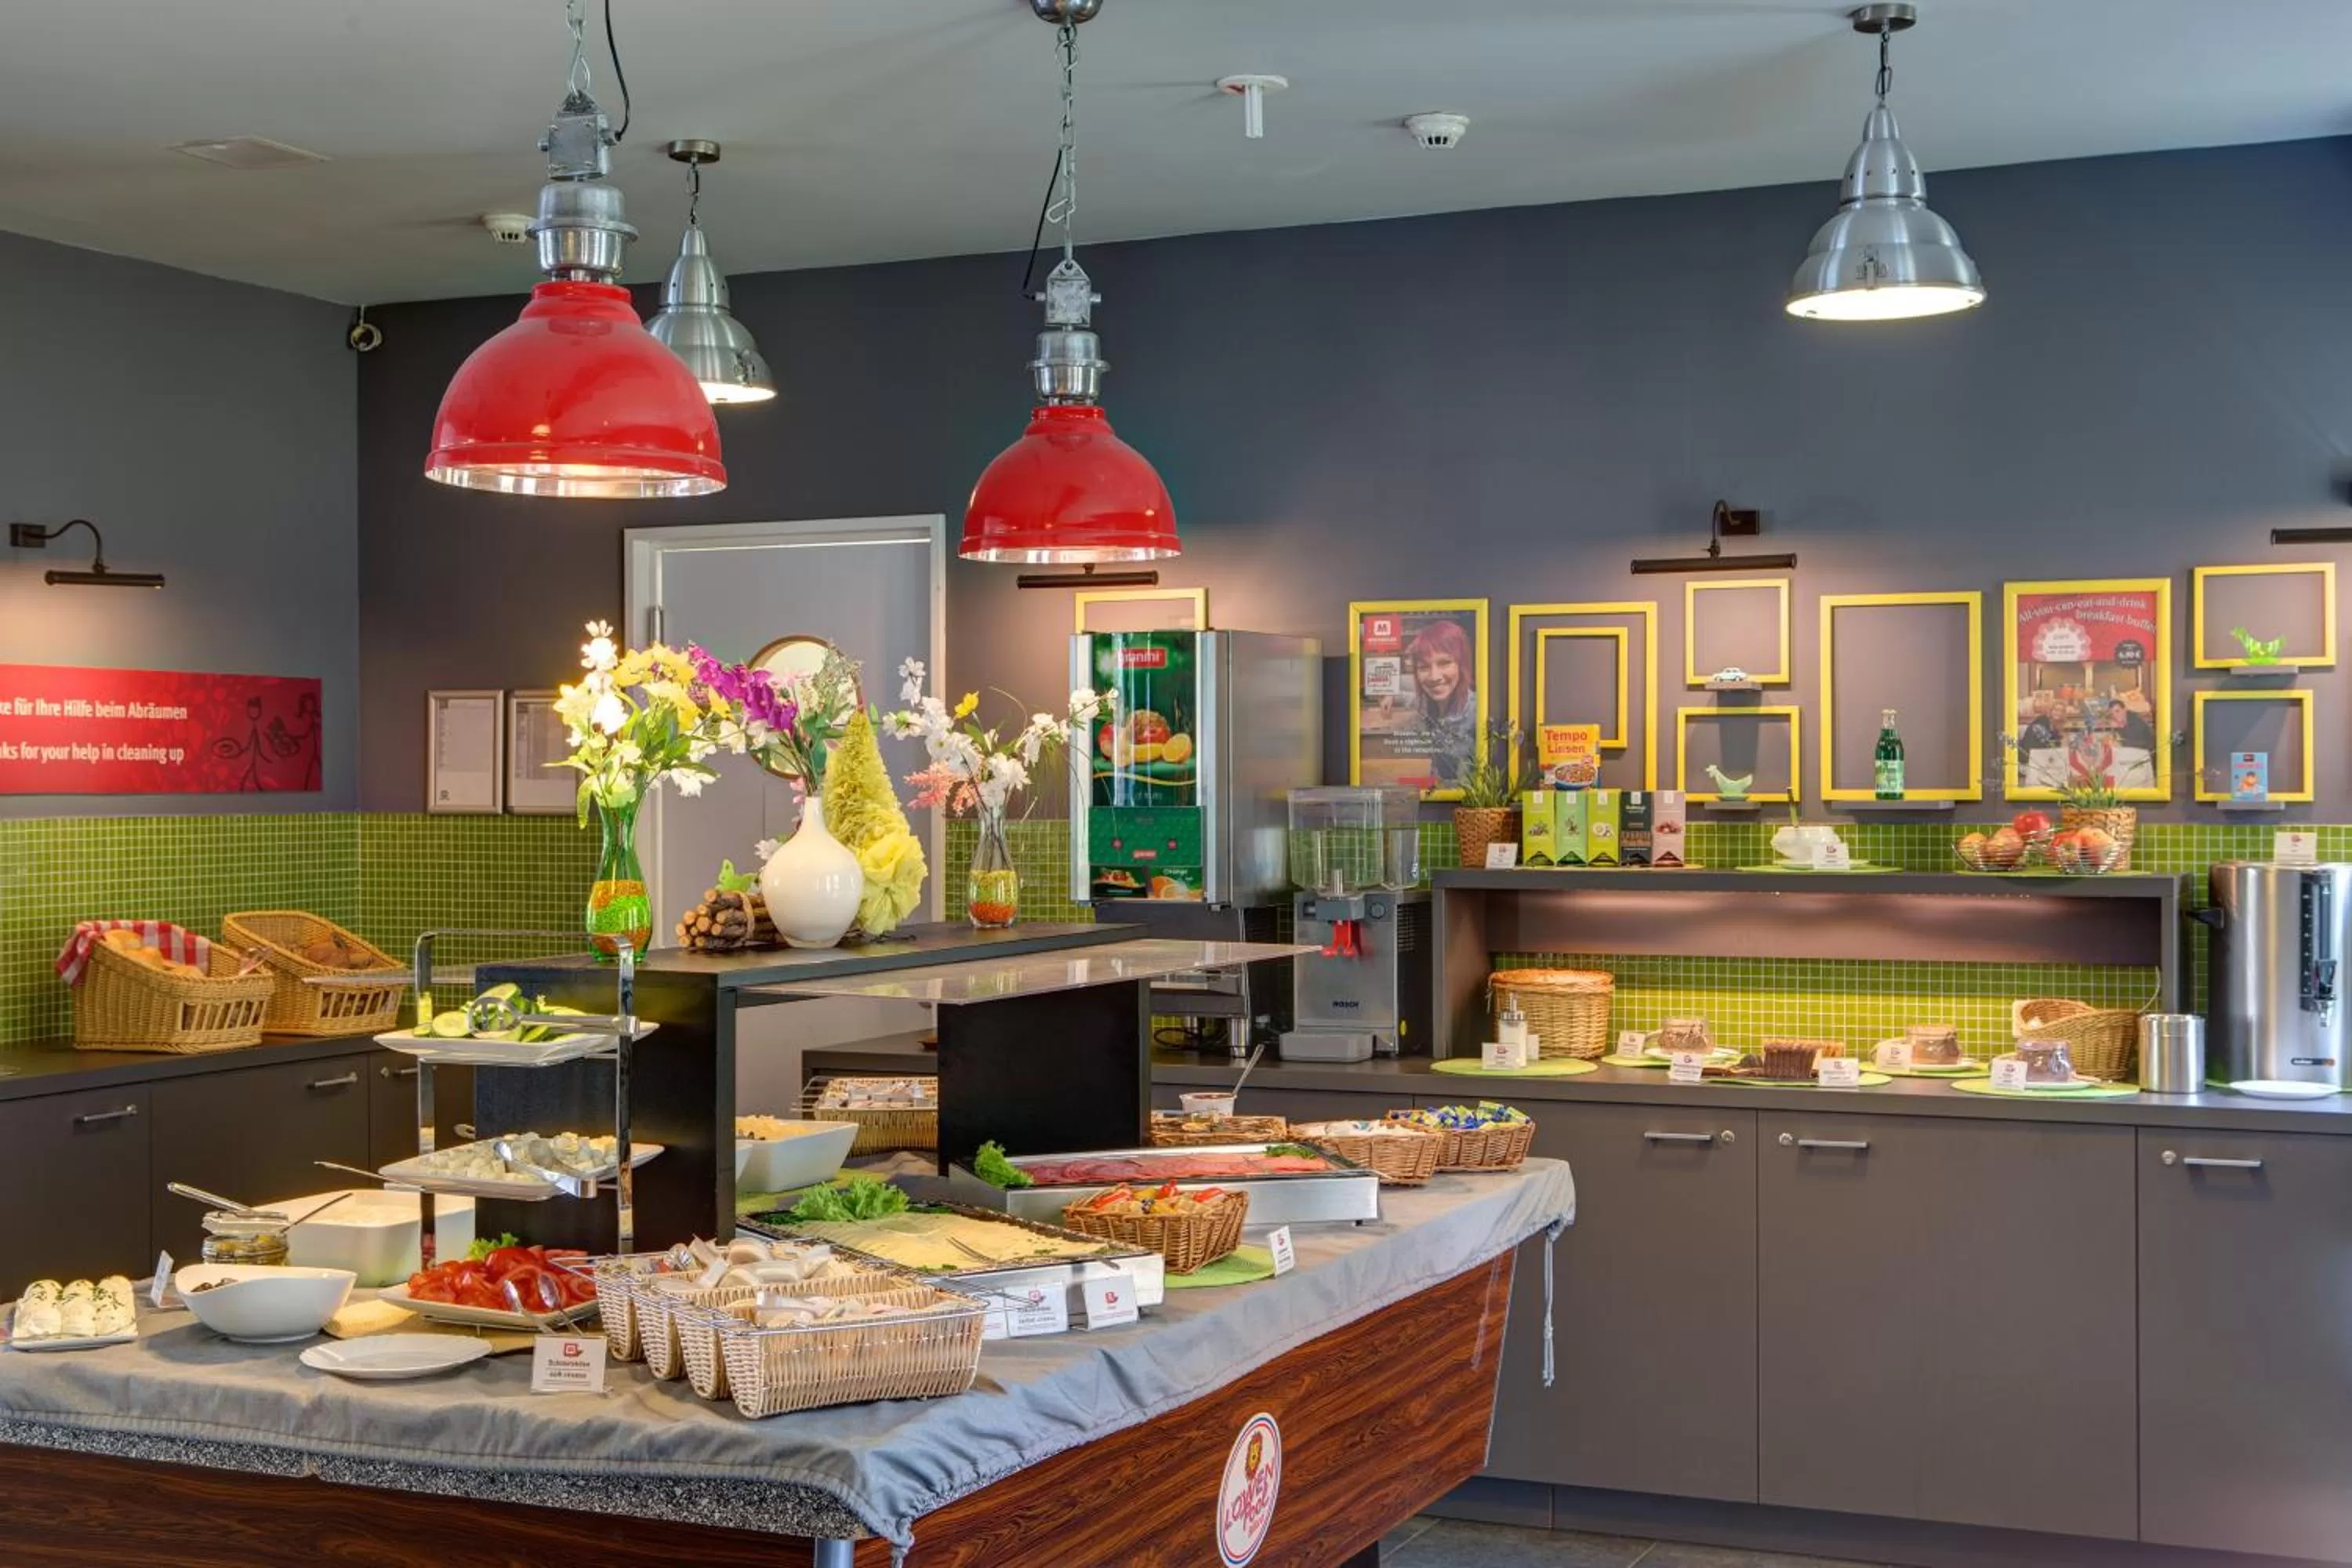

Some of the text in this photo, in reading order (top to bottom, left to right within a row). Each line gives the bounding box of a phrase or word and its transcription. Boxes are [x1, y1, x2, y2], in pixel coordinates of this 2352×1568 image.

[14, 697, 34, 716] für
[35, 698, 62, 716] Ihre
[64, 699, 93, 717] Hilfe
[95, 700, 125, 718] beim
[127, 702, 187, 720] Abräumen
[1544, 729, 1588, 742] Tempo
[0, 741, 185, 765] ks for your help in cleaning up
[1547, 743, 1585, 753] Linsen
